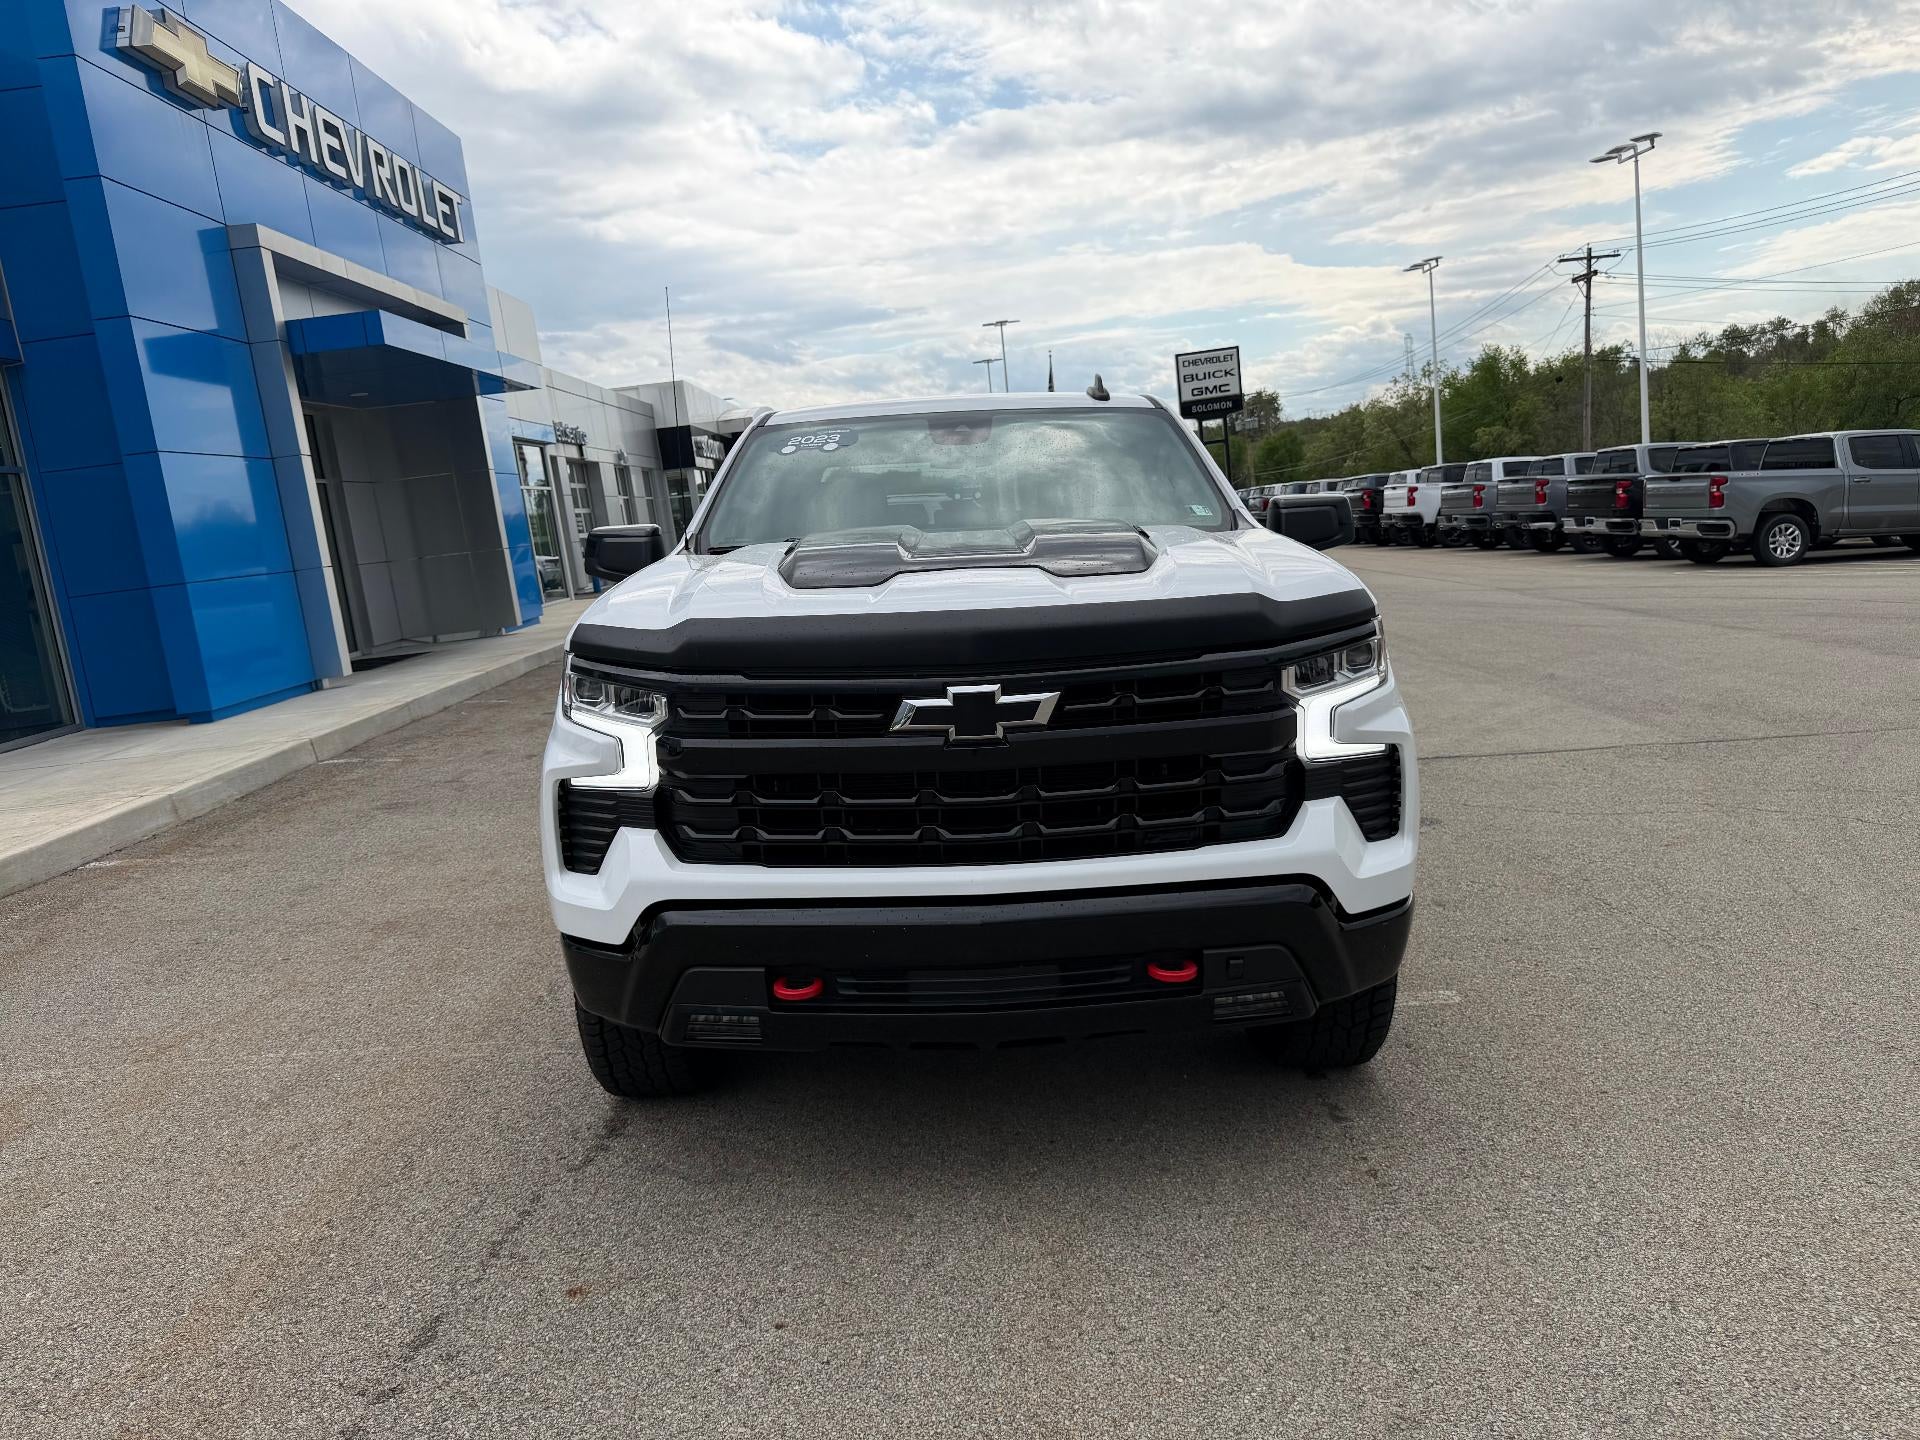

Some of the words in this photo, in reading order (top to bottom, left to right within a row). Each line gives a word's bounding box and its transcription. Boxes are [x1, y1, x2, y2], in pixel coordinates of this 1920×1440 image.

[246, 62, 465, 243] CHEVROLET
[1182, 353, 1234, 368] CHEVROLET
[1183, 368, 1236, 383] BUICK
[1191, 384, 1231, 397] GMC
[1191, 400, 1233, 413] SOLOMON
[788, 434, 841, 445] 2023
